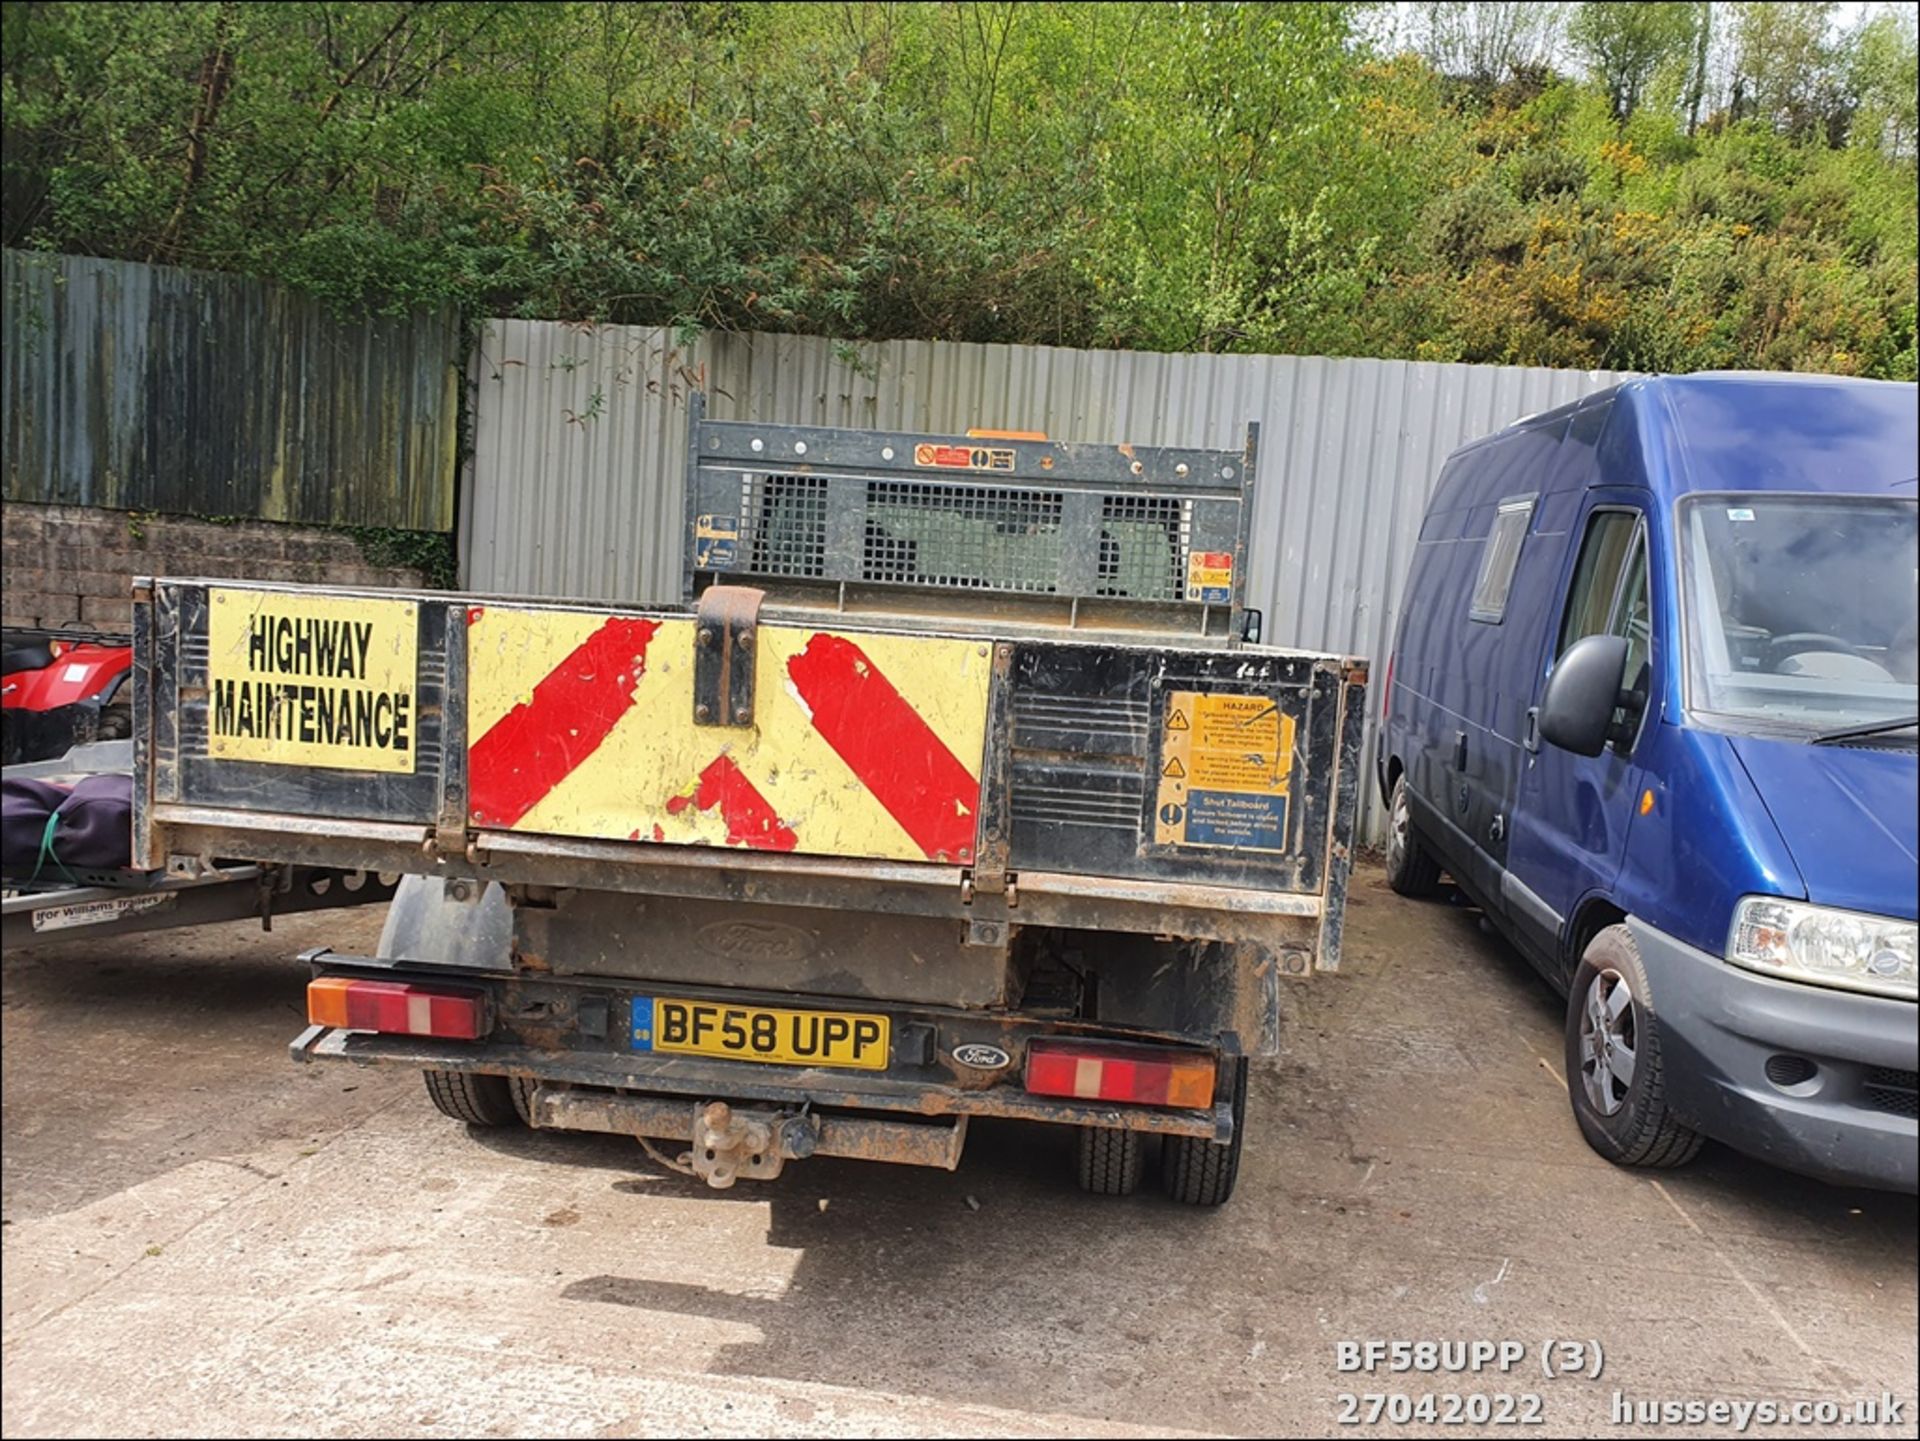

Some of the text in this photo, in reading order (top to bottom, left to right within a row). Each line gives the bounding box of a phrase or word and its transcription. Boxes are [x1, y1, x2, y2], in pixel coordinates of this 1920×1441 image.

[249, 614, 373, 680] HIGHWAY
[214, 679, 410, 751] MAINTENANCE
[1223, 702, 1264, 711] HAZARD
[1203, 797, 1270, 811] Shut Tailboard
[36, 909, 59, 922] Ifor
[63, 902, 114, 917] Williams
[662, 1004, 881, 1059] BF58 UPP
[964, 1047, 998, 1064] Ford
